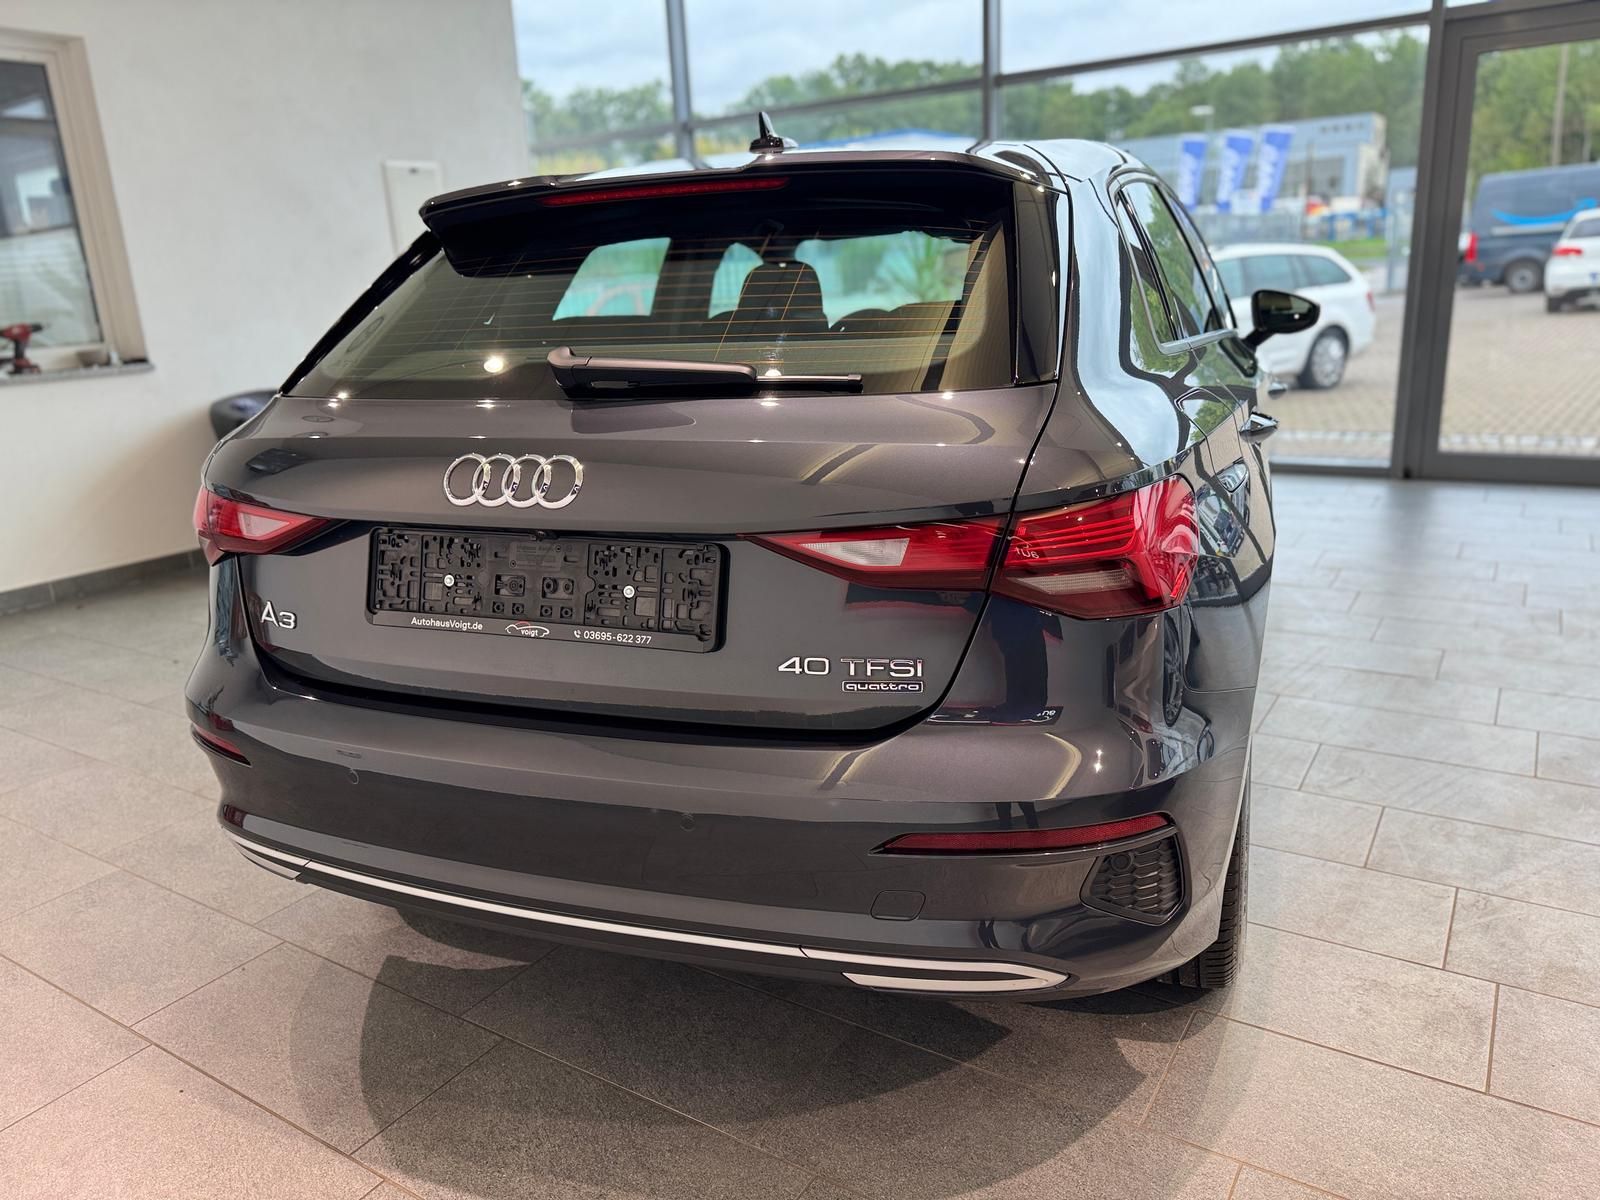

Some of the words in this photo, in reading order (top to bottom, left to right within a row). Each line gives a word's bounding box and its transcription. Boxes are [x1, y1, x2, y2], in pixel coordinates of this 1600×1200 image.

[260, 600, 296, 629] A3
[410, 616, 484, 631] AutohausVoigt.de
[635, 634, 652, 645] 377
[777, 656, 830, 675] 40
[840, 658, 924, 677] TFSI
[844, 681, 921, 693] quattro
